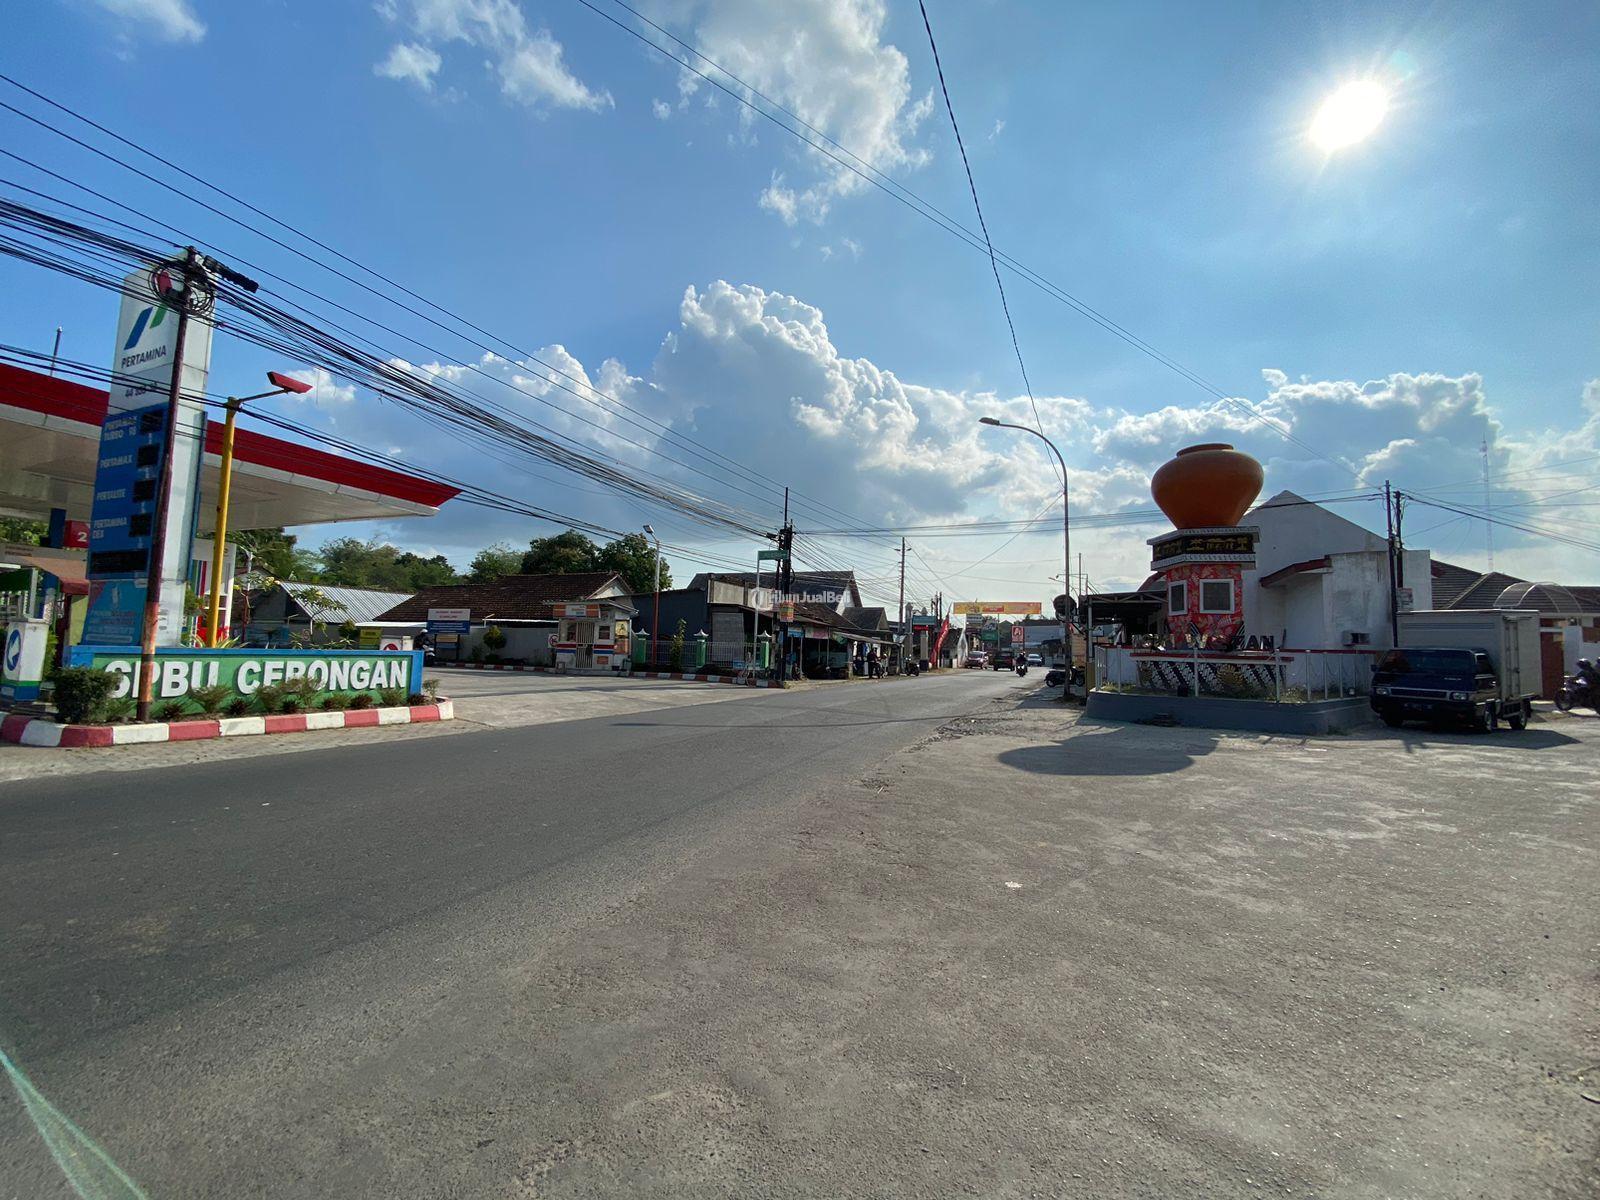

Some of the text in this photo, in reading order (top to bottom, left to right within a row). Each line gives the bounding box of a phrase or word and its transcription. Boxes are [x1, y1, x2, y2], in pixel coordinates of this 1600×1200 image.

[121, 345, 167, 369] PERTAMINA
[77, 532, 88, 542] 2
[103, 660, 220, 698] SPBU
